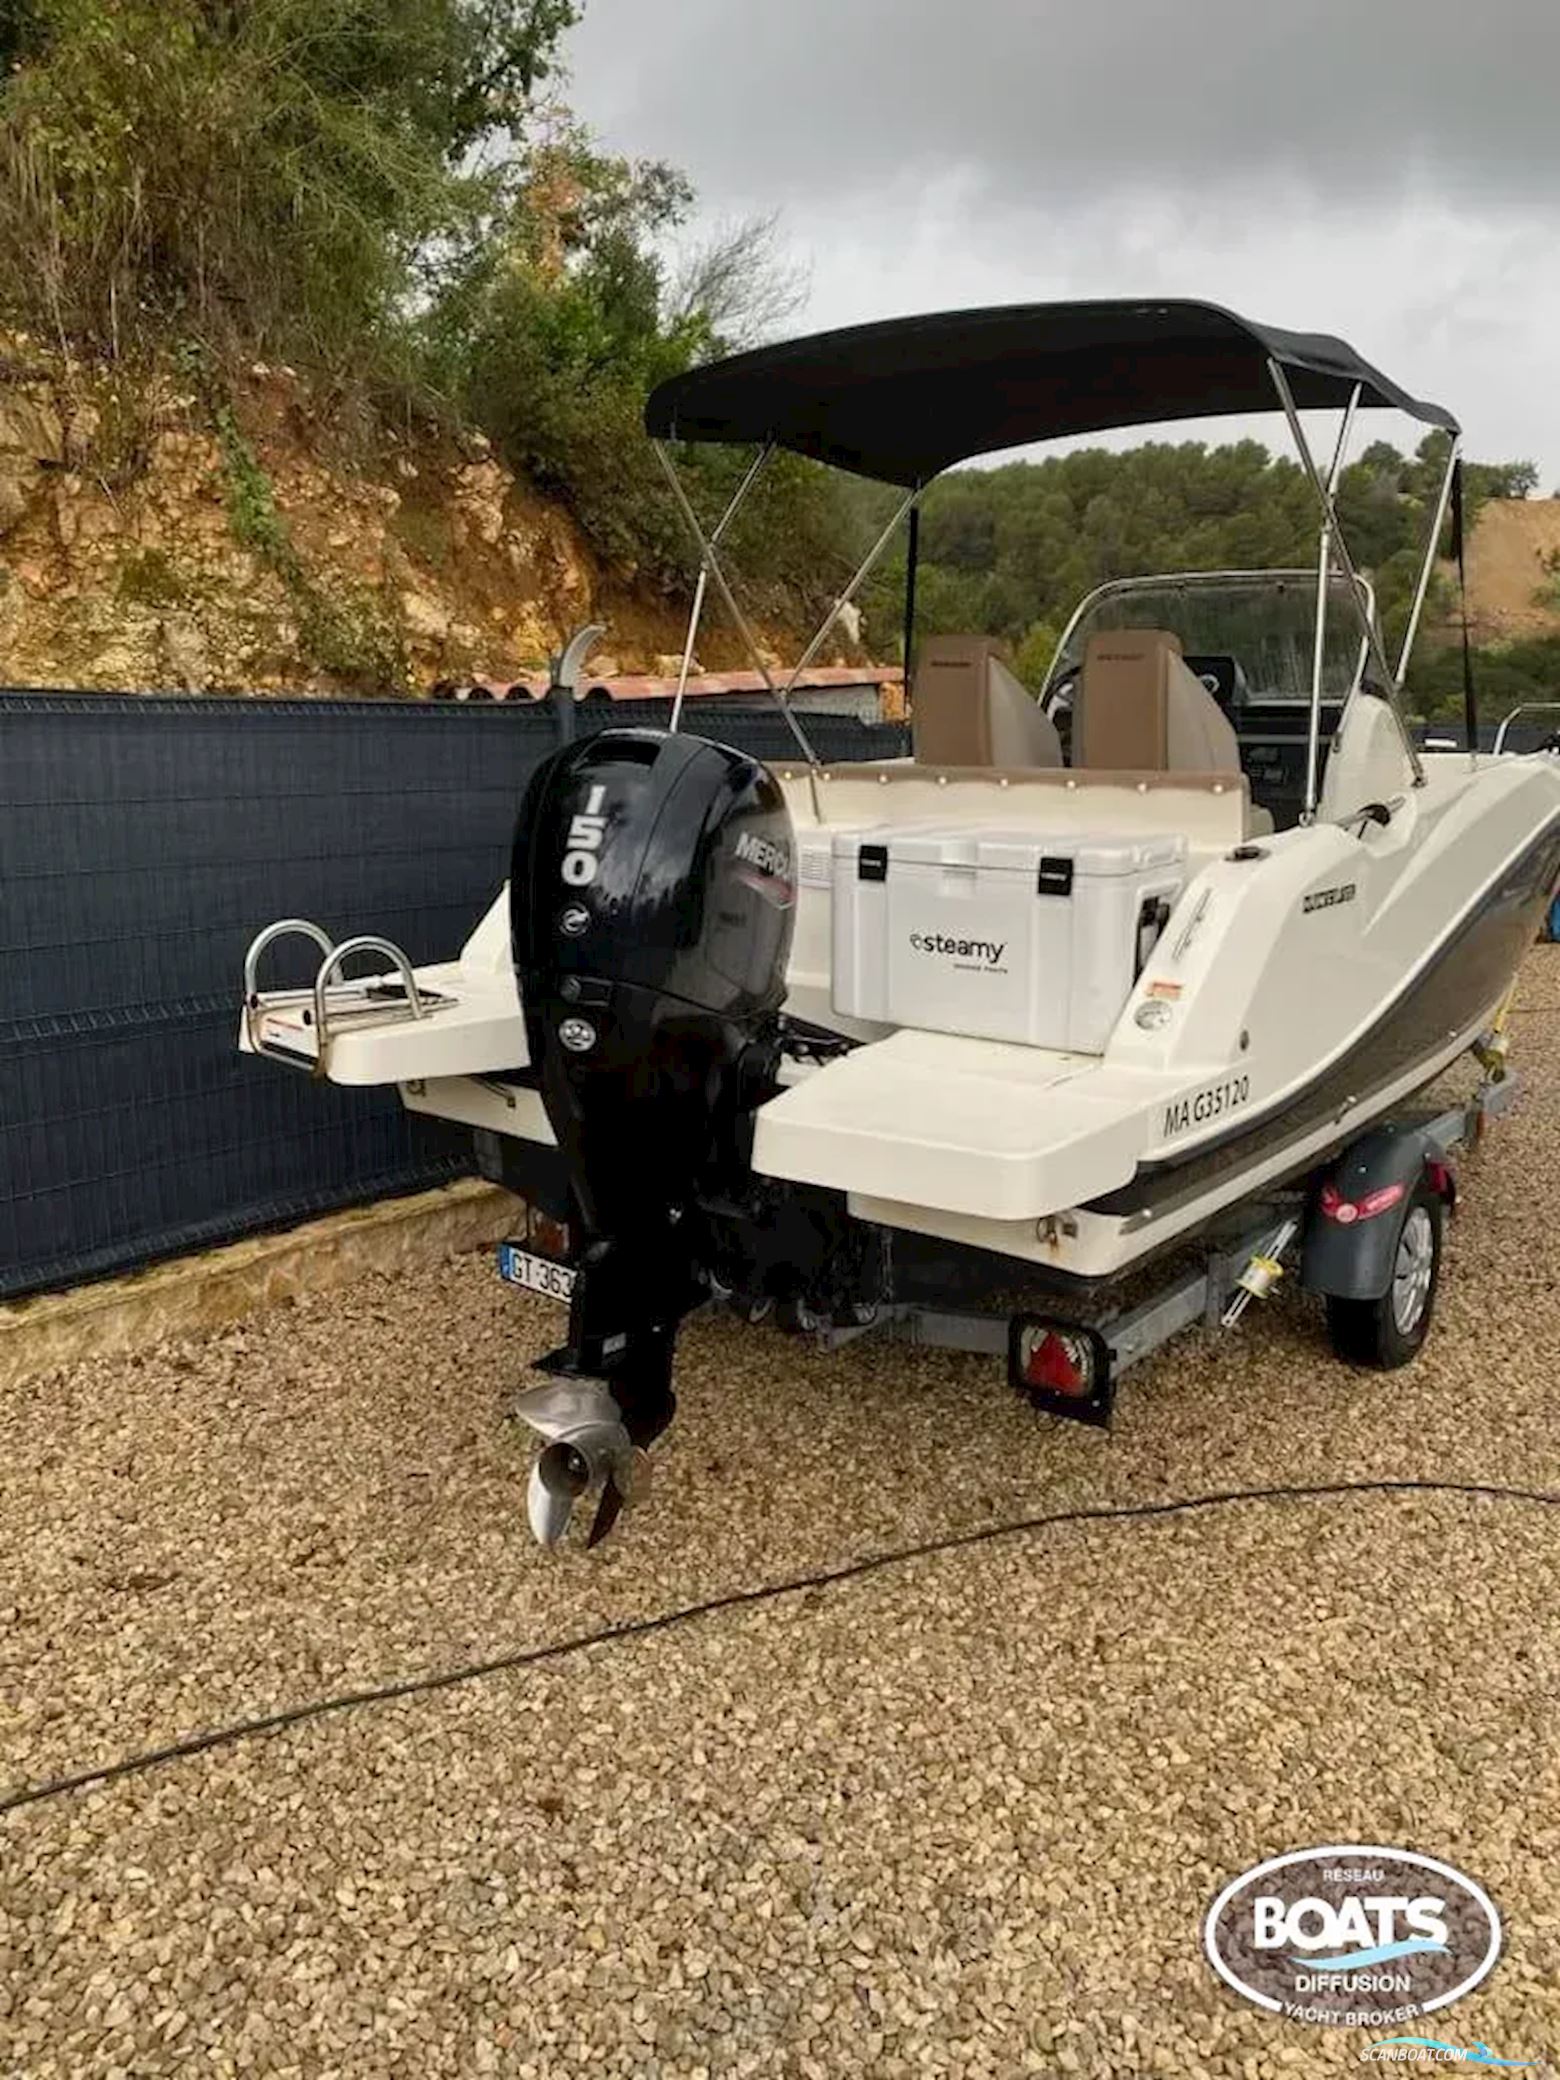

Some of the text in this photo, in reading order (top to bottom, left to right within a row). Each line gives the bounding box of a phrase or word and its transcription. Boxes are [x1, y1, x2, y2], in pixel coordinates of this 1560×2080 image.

[561, 785, 606, 886] 150
[923, 933, 1004, 964] steamy
[1163, 1074, 1250, 1138] MA G35120
